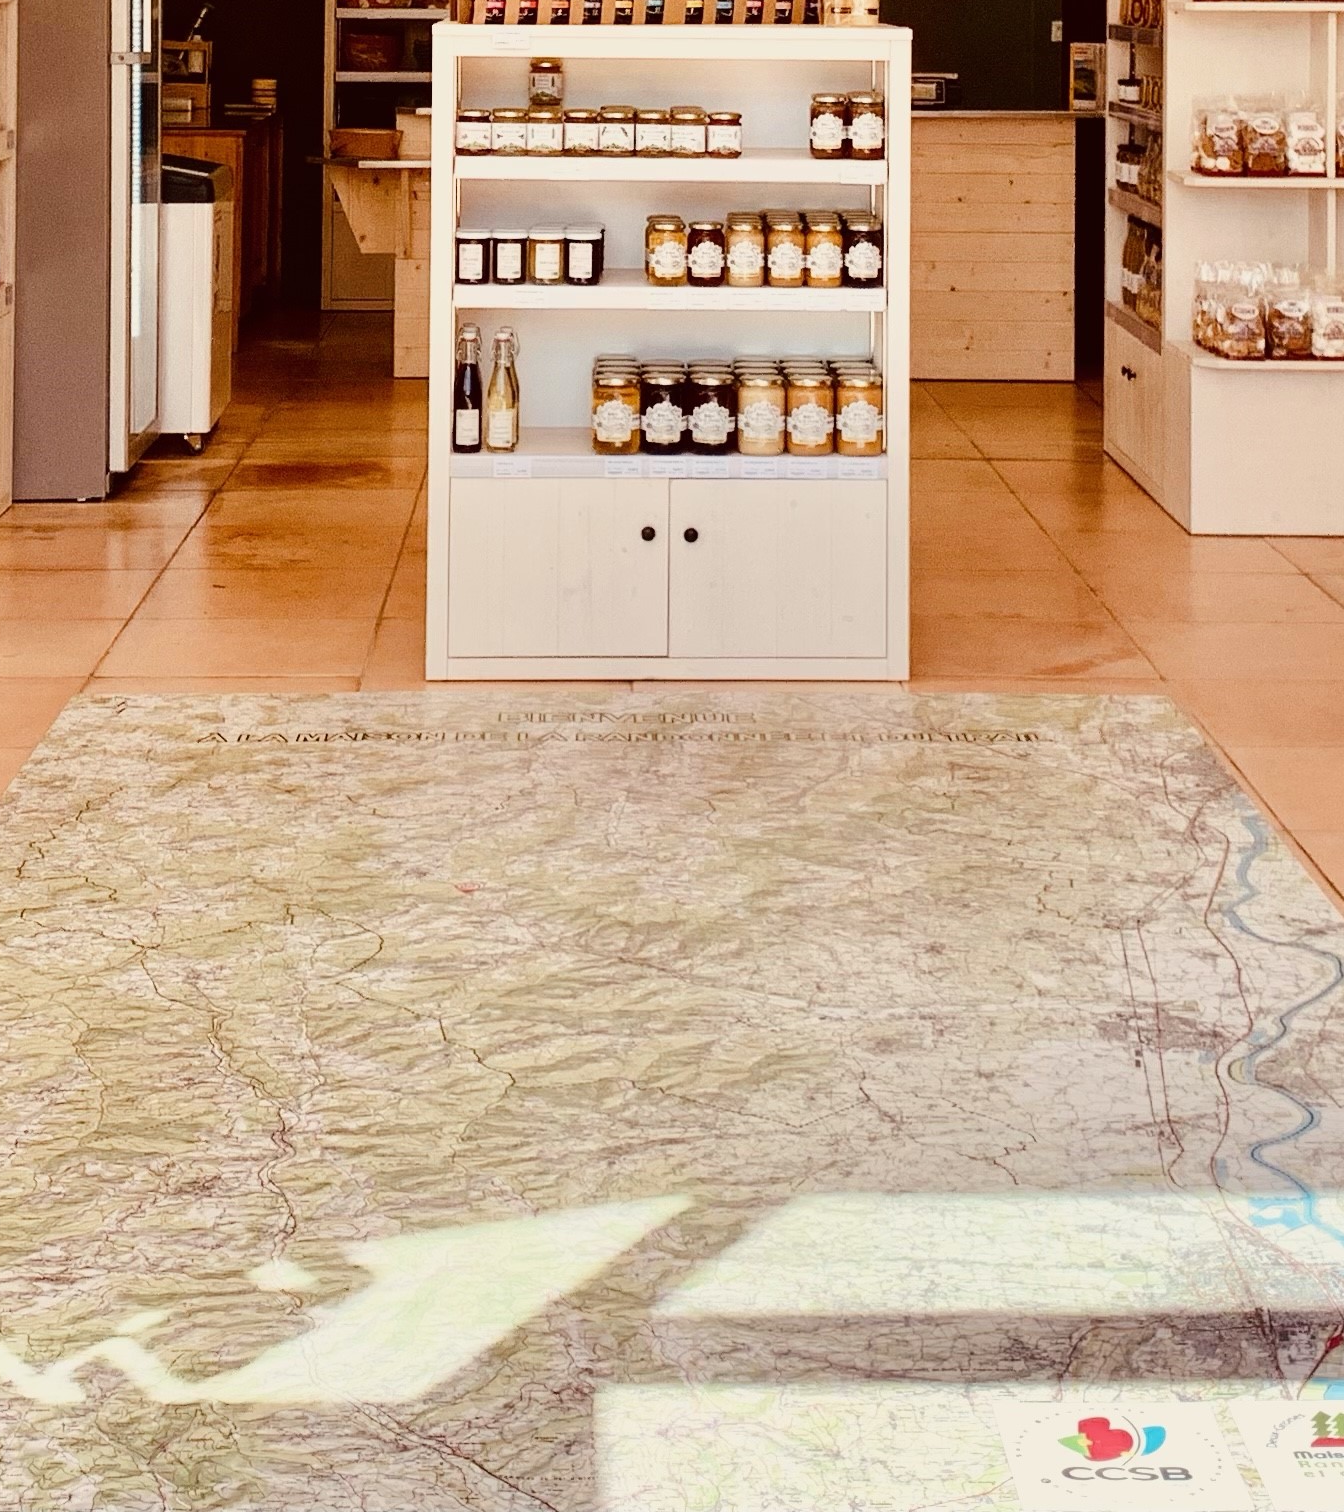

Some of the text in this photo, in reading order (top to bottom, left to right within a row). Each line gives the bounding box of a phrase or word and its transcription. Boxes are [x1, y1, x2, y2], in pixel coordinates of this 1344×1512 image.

[498, 712, 757, 724] BIENVENUE
[237, 733, 289, 744] LA
[295, 732, 446, 744] MAISON
[1060, 1466, 1193, 1481] CCSB
[1303, 1469, 1326, 1478] et
